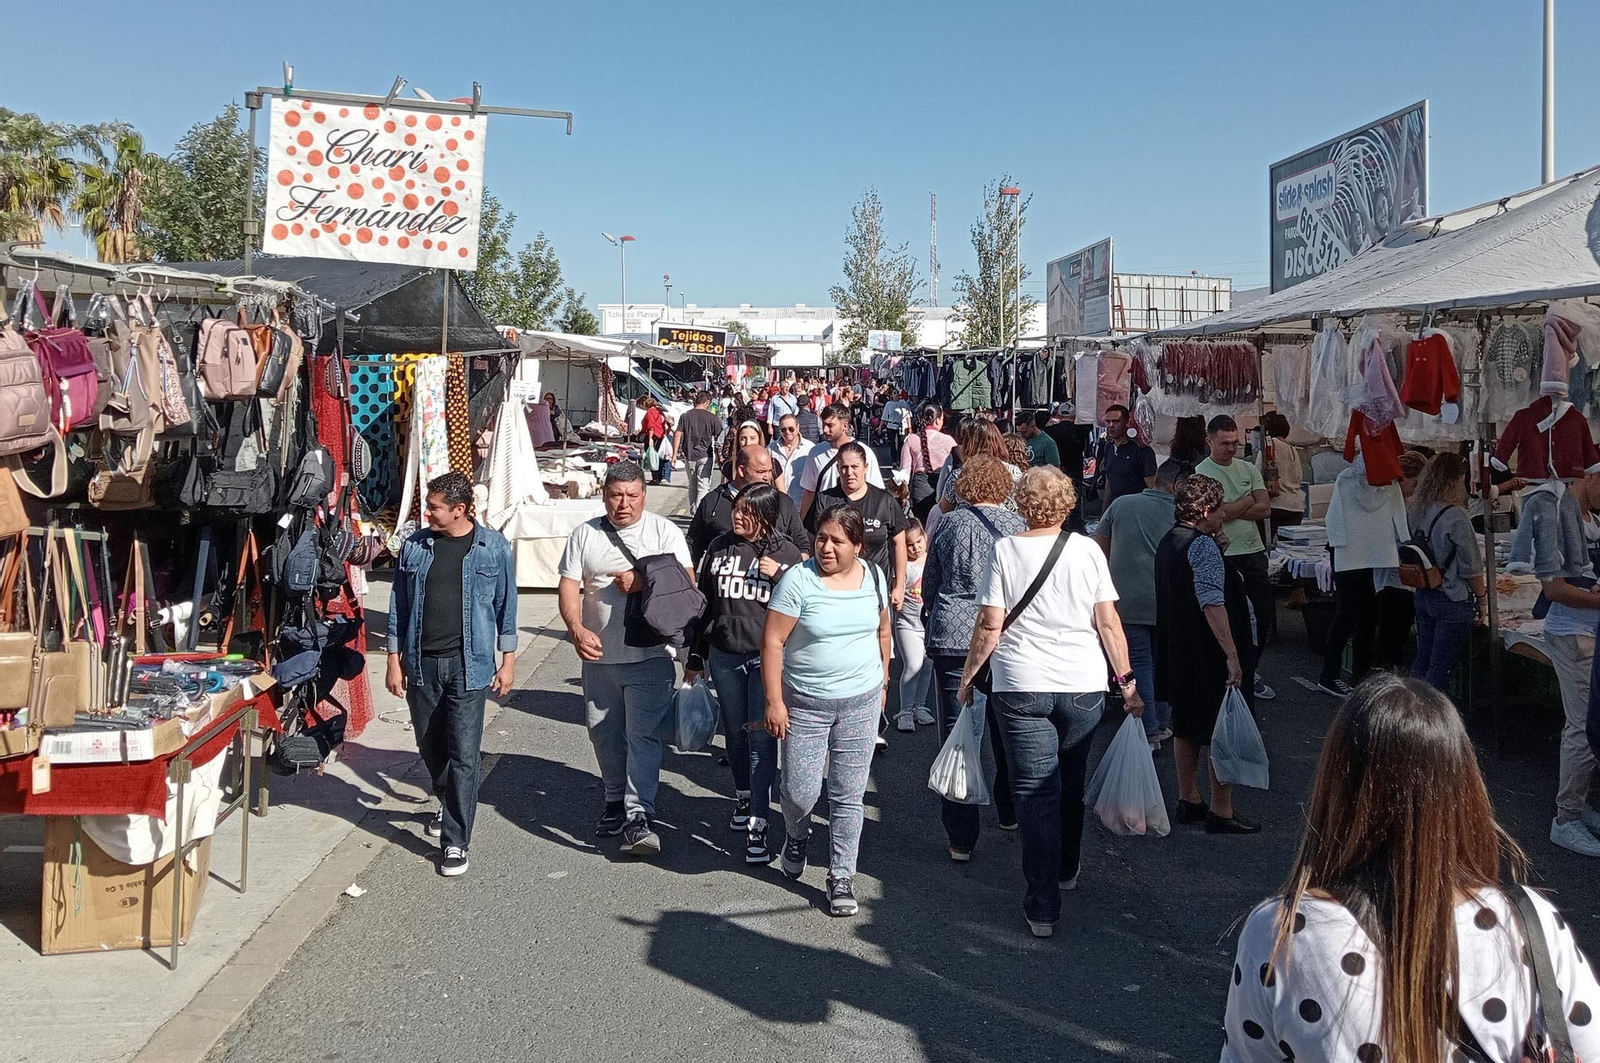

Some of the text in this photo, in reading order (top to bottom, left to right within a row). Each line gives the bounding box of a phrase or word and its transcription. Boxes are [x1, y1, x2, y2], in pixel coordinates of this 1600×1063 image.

[325, 128, 430, 170] Chari
[275, 185, 469, 235] Fernández
[671, 329, 714, 343] Tejidos
[717, 575, 771, 603] HOOD
